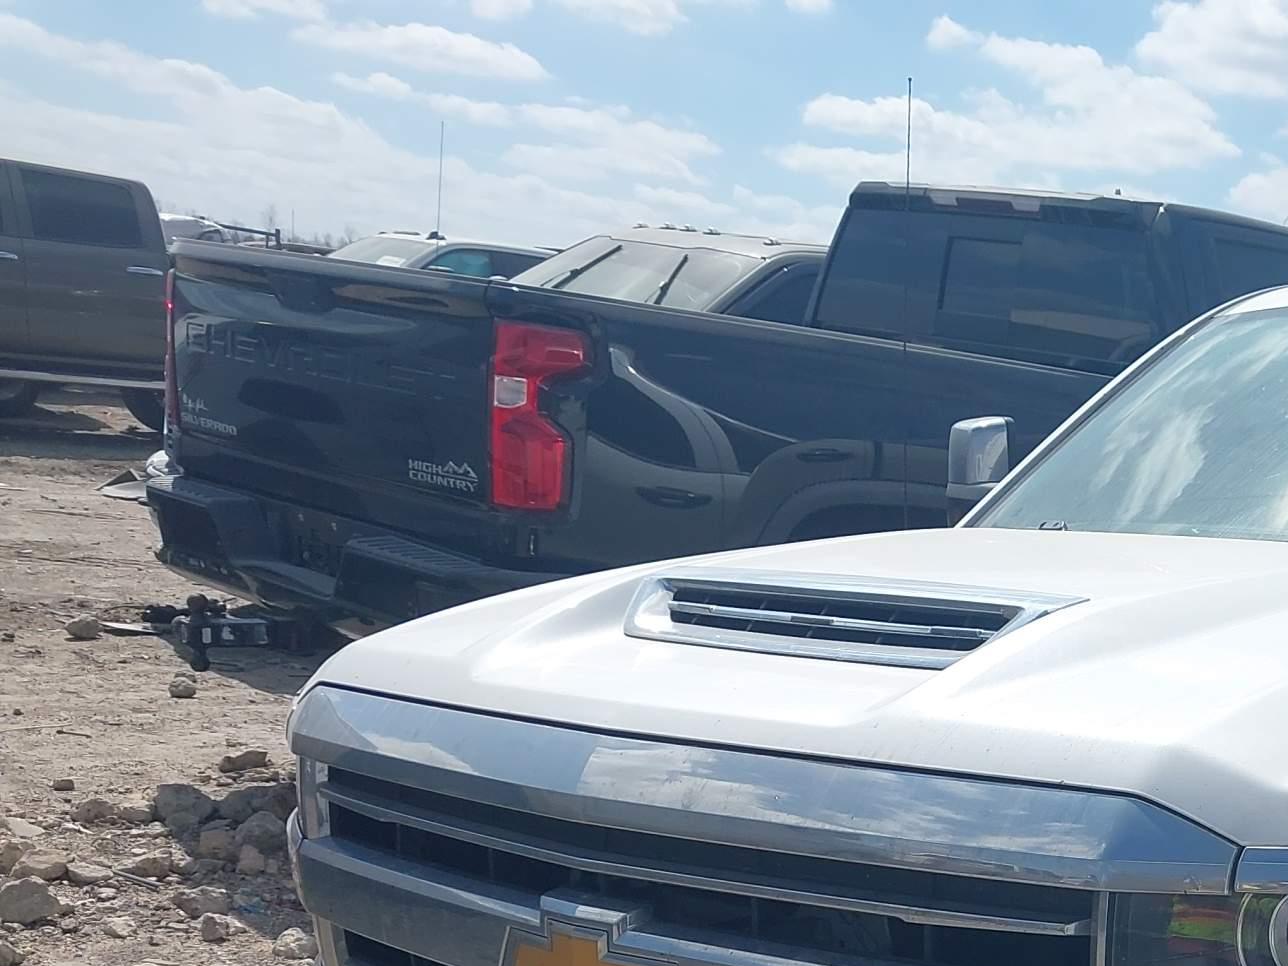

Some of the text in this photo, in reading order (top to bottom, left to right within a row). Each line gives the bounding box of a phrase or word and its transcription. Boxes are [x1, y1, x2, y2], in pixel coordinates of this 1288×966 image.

[181, 411, 238, 436] SILVERADO
[408, 458, 442, 474] HIGH
[408, 470, 479, 492] COUNTRY
